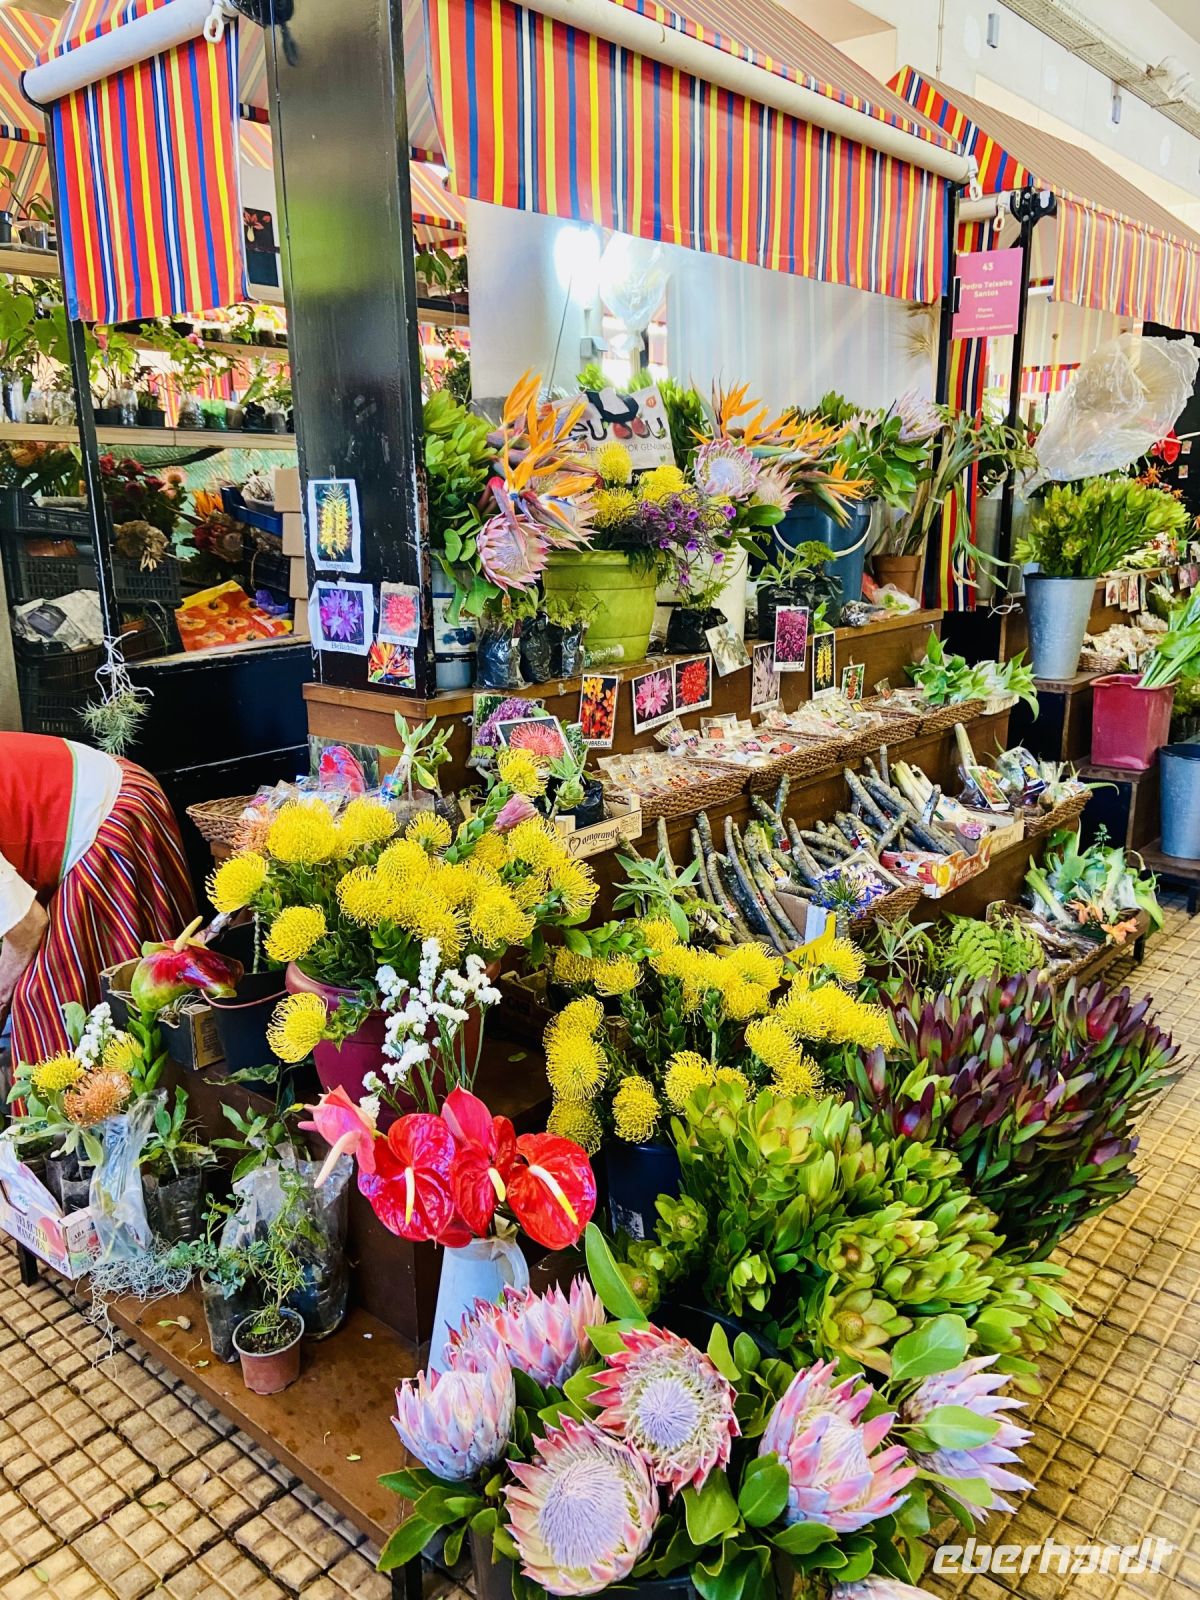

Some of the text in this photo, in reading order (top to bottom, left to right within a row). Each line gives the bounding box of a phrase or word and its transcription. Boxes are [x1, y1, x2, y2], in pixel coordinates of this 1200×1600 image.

[961, 280, 1013, 291] Pedro Teixeira
[974, 290, 999, 298] Santos
